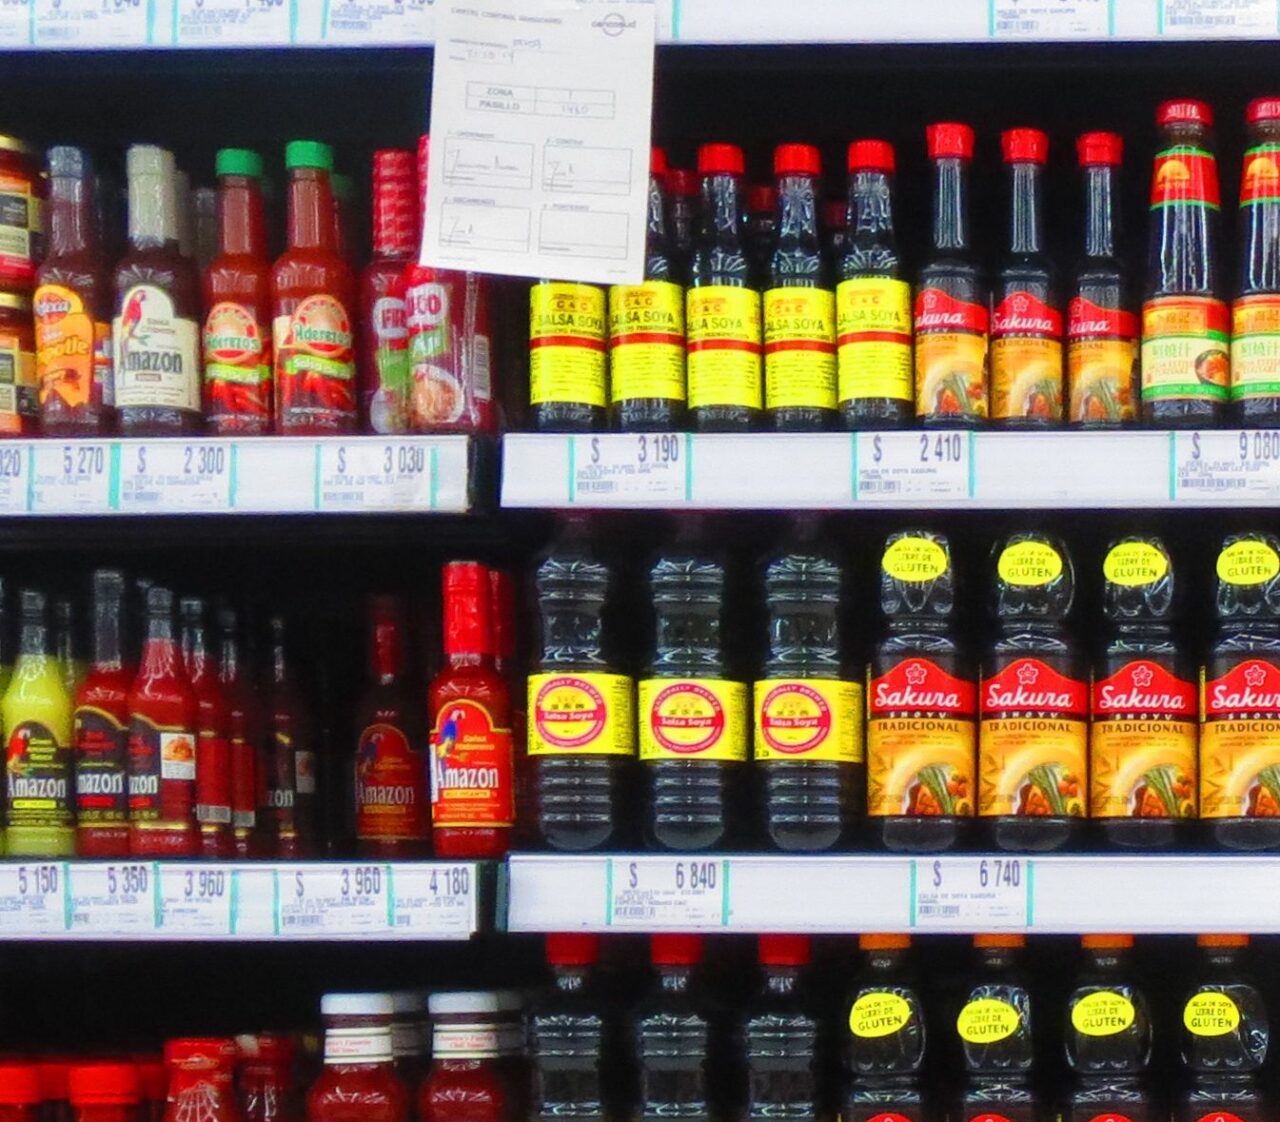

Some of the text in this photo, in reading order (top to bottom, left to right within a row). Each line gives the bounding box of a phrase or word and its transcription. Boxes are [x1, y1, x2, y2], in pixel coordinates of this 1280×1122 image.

[1008, 566, 1053, 578] GLUTEN
[1113, 567, 1157, 578] GLUTEN
[1228, 566, 1271, 576] GLUTEN
[875, 684, 961, 708] Sakura
[986, 684, 1073, 708] Sakura
[1100, 685, 1185, 710] Sakura
[878, 723, 959, 732] TRADICIONAL
[1102, 724, 1184, 734] TRADICIONAL
[435, 765, 500, 788] Amazon
[858, 1015, 902, 1031] GLUTEN
[1082, 1016, 1126, 1029] GLUTEN
